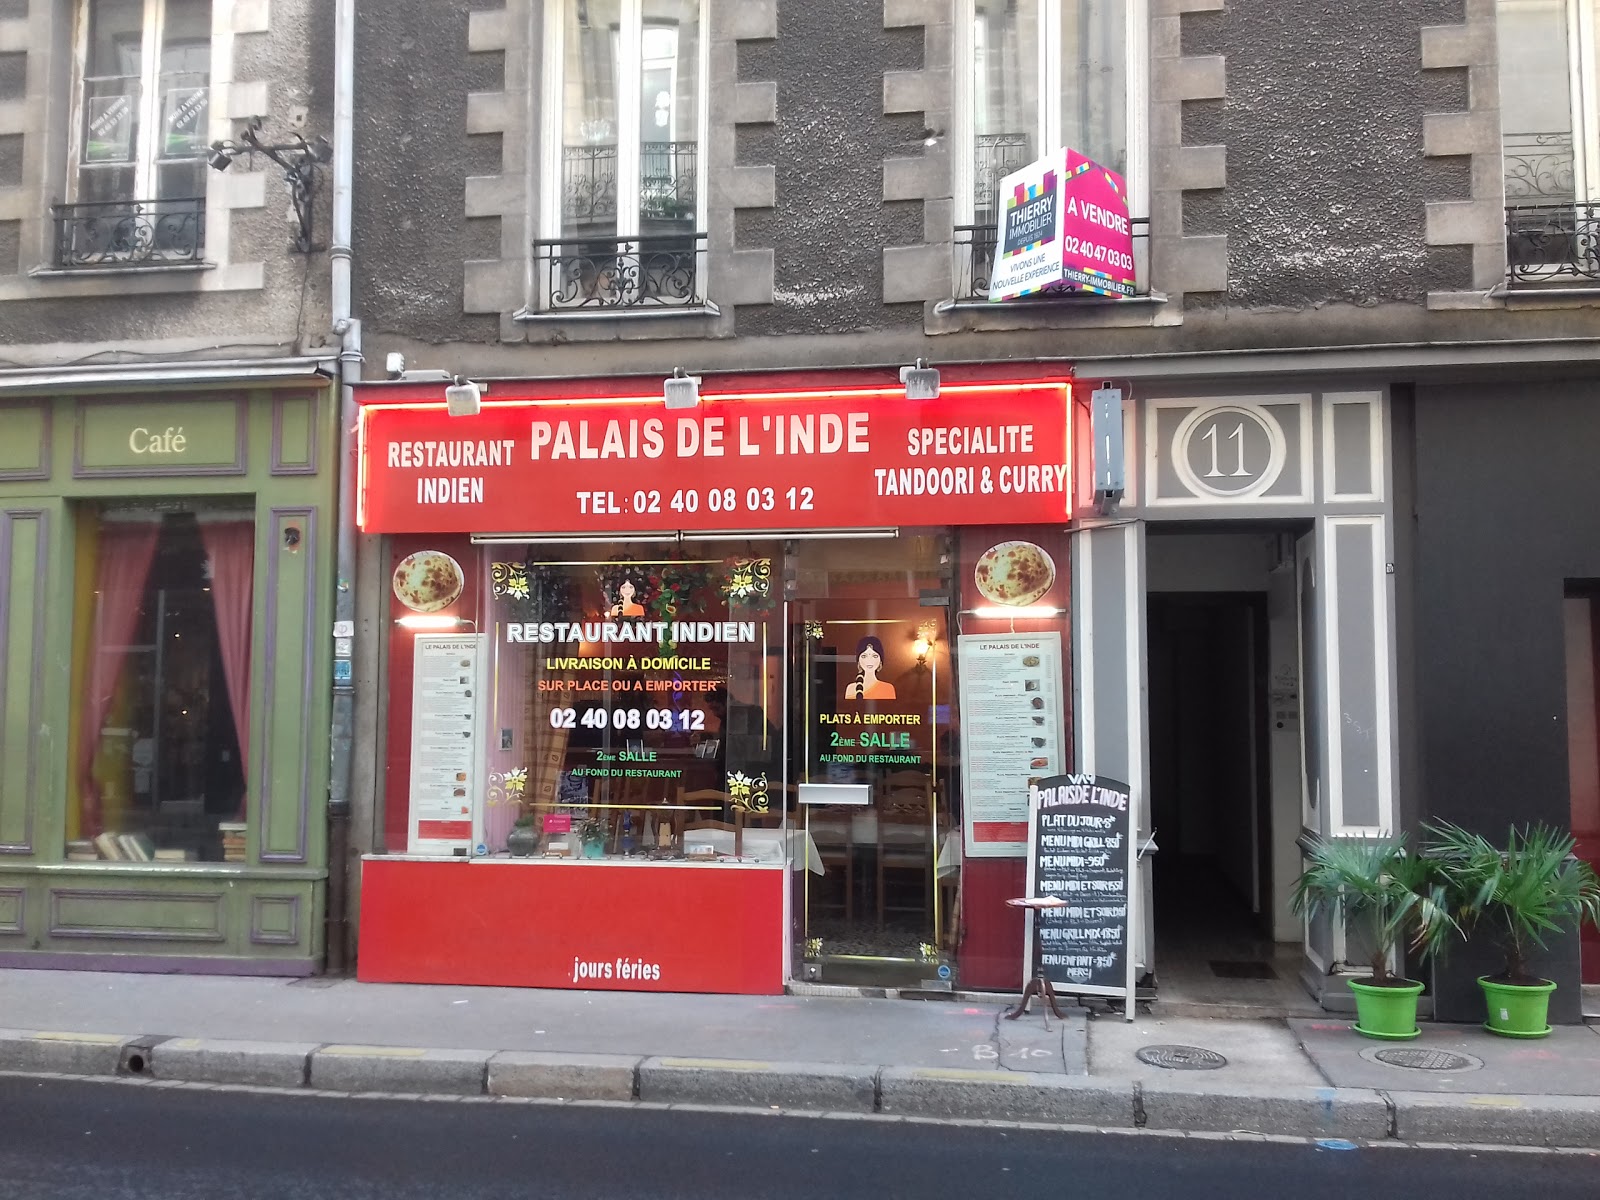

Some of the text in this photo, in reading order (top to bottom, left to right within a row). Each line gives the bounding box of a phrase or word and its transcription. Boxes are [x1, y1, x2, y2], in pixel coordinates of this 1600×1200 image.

[1010, 194, 1053, 227] THIERRY
[1067, 196, 1129, 235] A VENDRE
[1009, 212, 1052, 240] IMMOBILIER
[1010, 252, 1046, 273] VIVONS UNE
[1065, 235, 1132, 270] 02 40 47 03 03
[993, 273, 1024, 290] NOUVELLE
[1063, 268, 1134, 296] THIERRY-IMMOBILIER.FR
[129, 426, 186, 453] Café
[531, 412, 870, 461] PALAIS DE L'INDE
[907, 425, 1034, 456] SPECIALITE
[387, 440, 515, 468] RESTAURANT
[1202, 422, 1253, 477] 11
[417, 477, 484, 504] INDIEN
[874, 464, 1067, 496] TANDOORI & CURRY
[633, 490, 662, 513] 02
[670, 489, 699, 513] 40
[708, 488, 737, 512] 08
[746, 487, 775, 511] 03
[785, 487, 814, 510] 12
[506, 621, 756, 643] RESTAURANT INDIEN
[546, 655, 711, 670] LIVRAISON À DOMICILE
[537, 680, 717, 691] SUR PLACE OU A EMPORTER
[550, 708, 705, 731] 02 40 08 03 12
[820, 711, 921, 725] PLATS À EMPORTER
[860, 732, 910, 748] SALLE
[619, 751, 657, 762] SALLE
[820, 754, 921, 764] AU FOND DU RESTAURANT
[571, 768, 682, 778] AU FOND DU RESTAURANT
[1042, 815, 1067, 827] PLAT
[1067, 815, 1080, 827] DU
[1080, 816, 1102, 828] JOUR
[1041, 835, 1067, 847] MENU
[1040, 856, 1066, 868] MENU
[1040, 880, 1065, 892] MENU
[1041, 907, 1065, 918] MENU
[1040, 928, 1062, 940] MENU
[572, 956, 661, 983] jours féries
[1061, 955, 1093, 967] ENFANT
